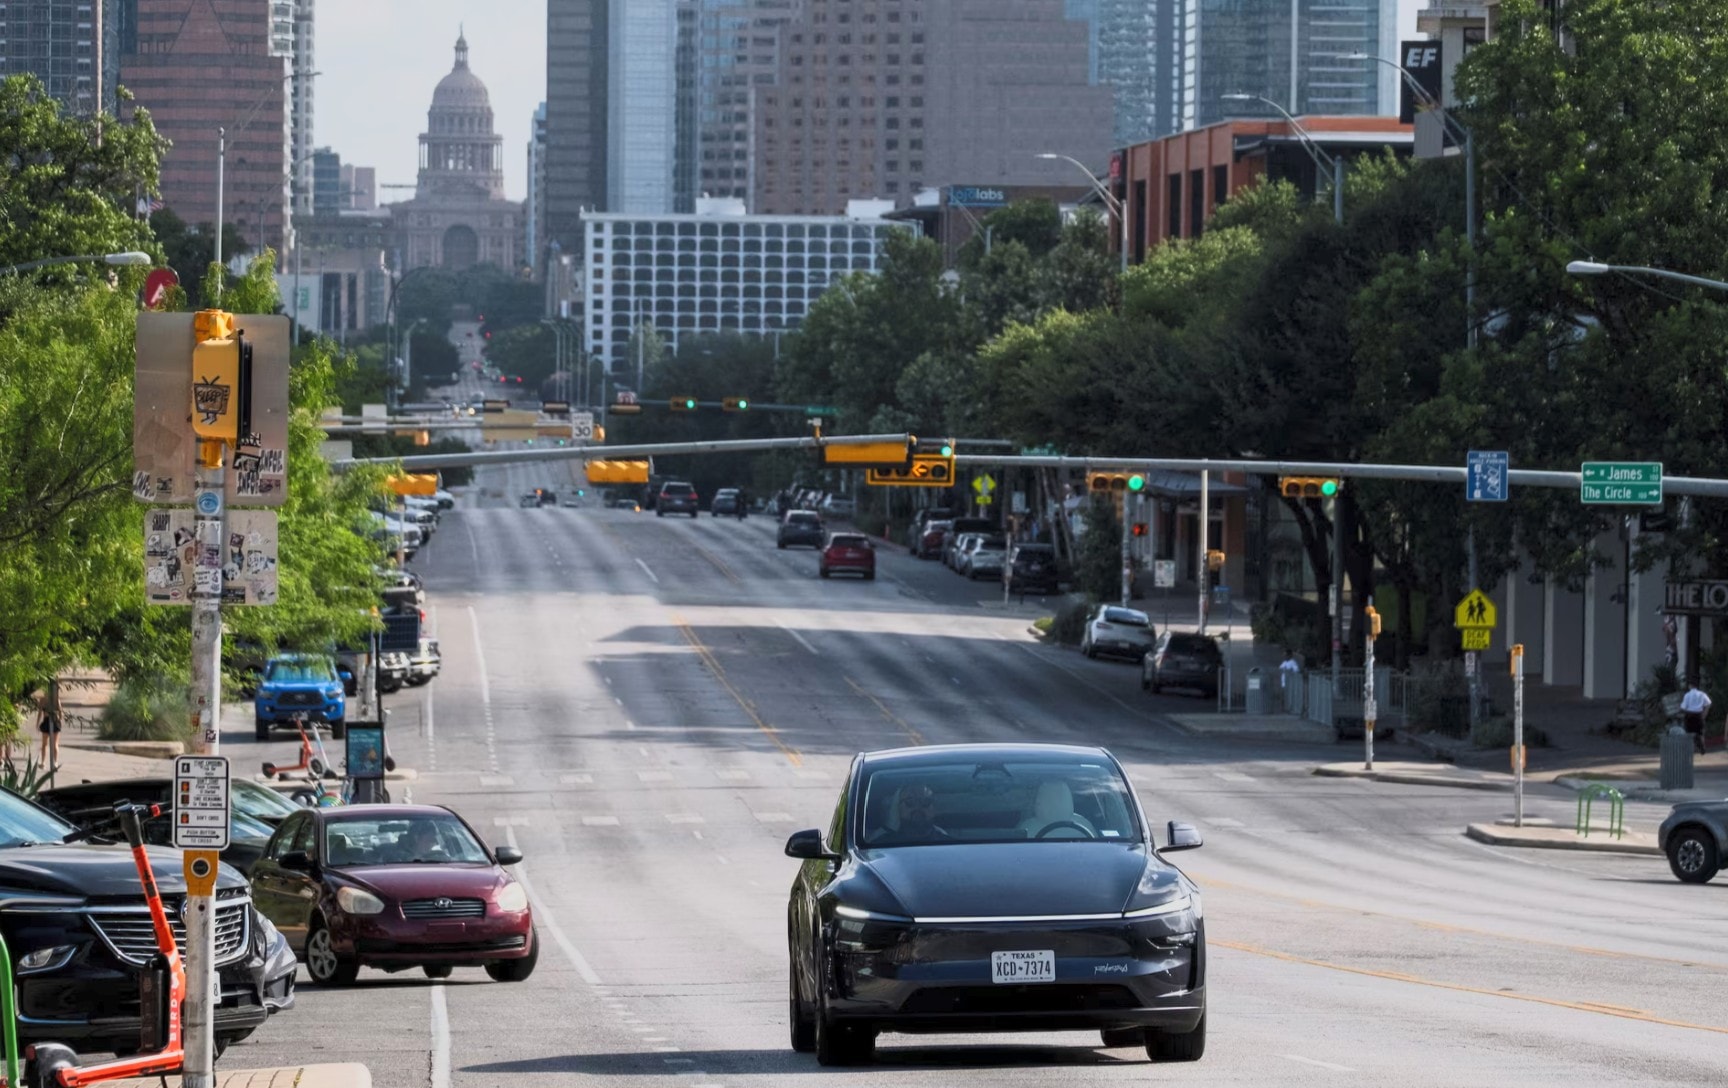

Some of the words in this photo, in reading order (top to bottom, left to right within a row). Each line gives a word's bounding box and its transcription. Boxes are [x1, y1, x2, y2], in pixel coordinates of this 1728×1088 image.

[1406, 48, 1438, 68] EF
[197, 388, 221, 403] SLEEP
[575, 426, 591, 437] 30
[1607, 466, 1643, 480] James
[1584, 486, 1601, 499] The
[1604, 486, 1632, 499] Circle
